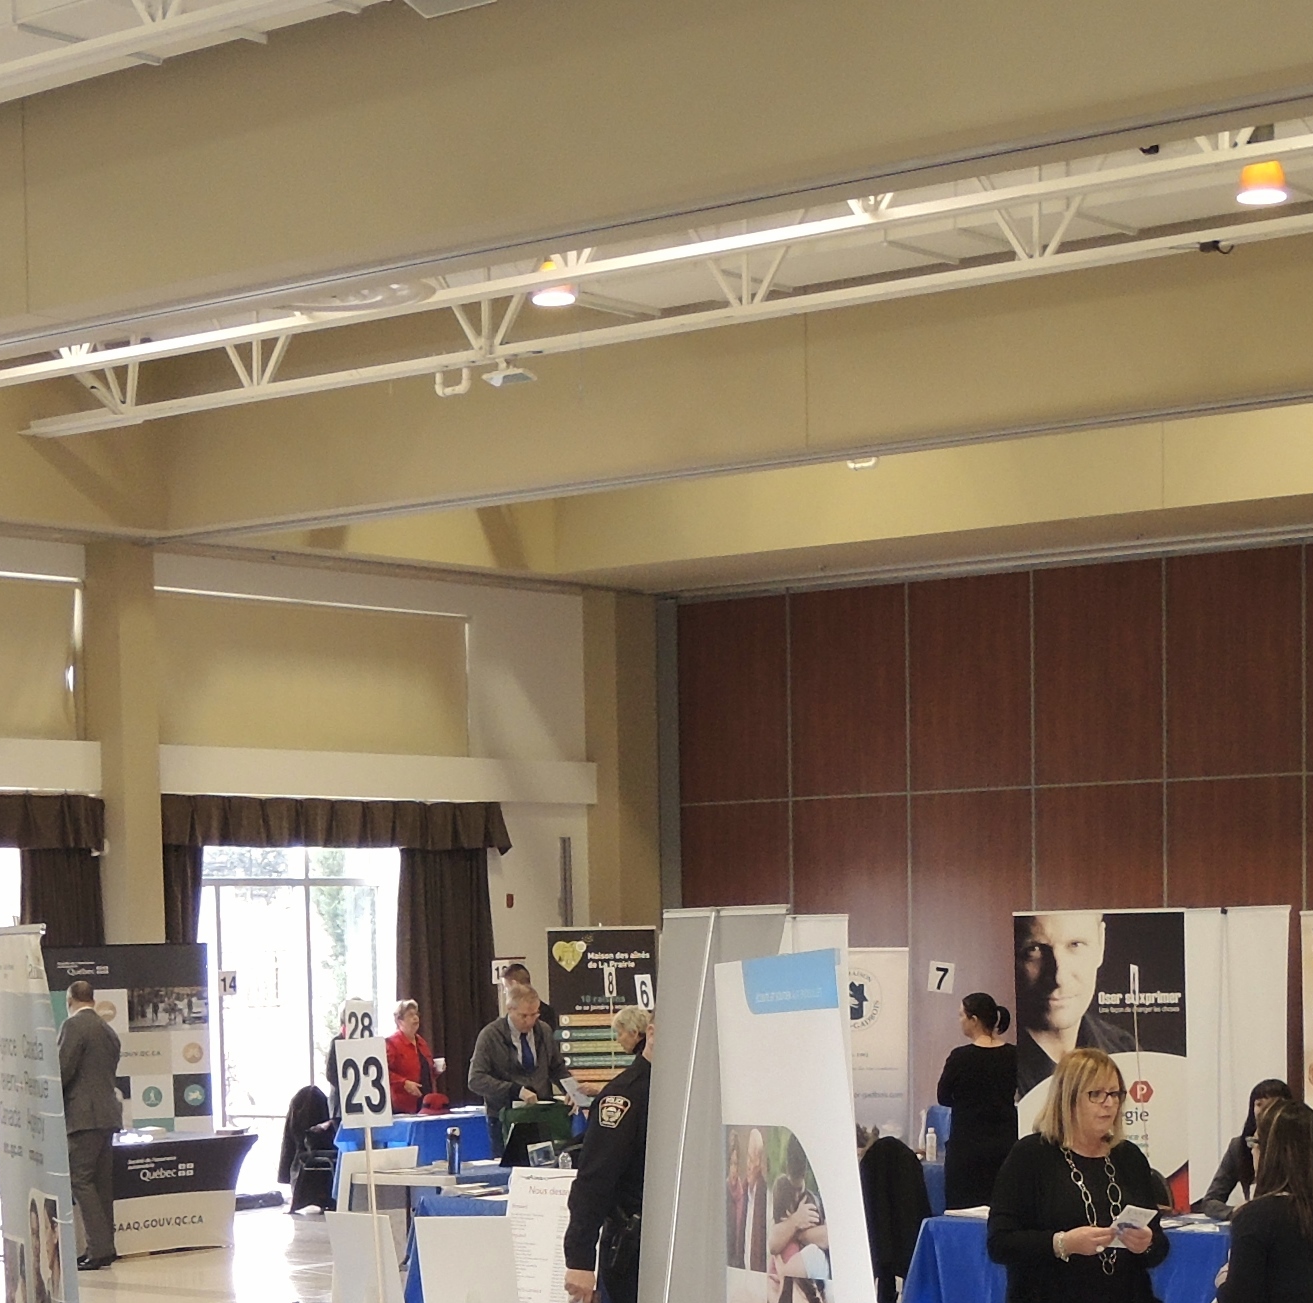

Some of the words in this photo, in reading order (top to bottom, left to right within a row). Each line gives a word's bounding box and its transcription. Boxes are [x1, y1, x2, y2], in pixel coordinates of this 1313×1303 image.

[588, 952, 614, 960] Maison
[615, 952, 629, 960] des
[610, 960, 635, 968] Prairie
[220, 976, 237, 992] 14
[607, 971, 615, 995] 8
[935, 966, 949, 991] 7
[639, 980, 650, 1009] 6
[1098, 991, 1123, 1005] Oser
[348, 1011, 374, 1039] 28
[341, 1056, 387, 1113] 23
[1136, 1084, 1148, 1100] P
[1125, 1107, 1149, 1126] gie
[139, 1167, 177, 1182] Québec
